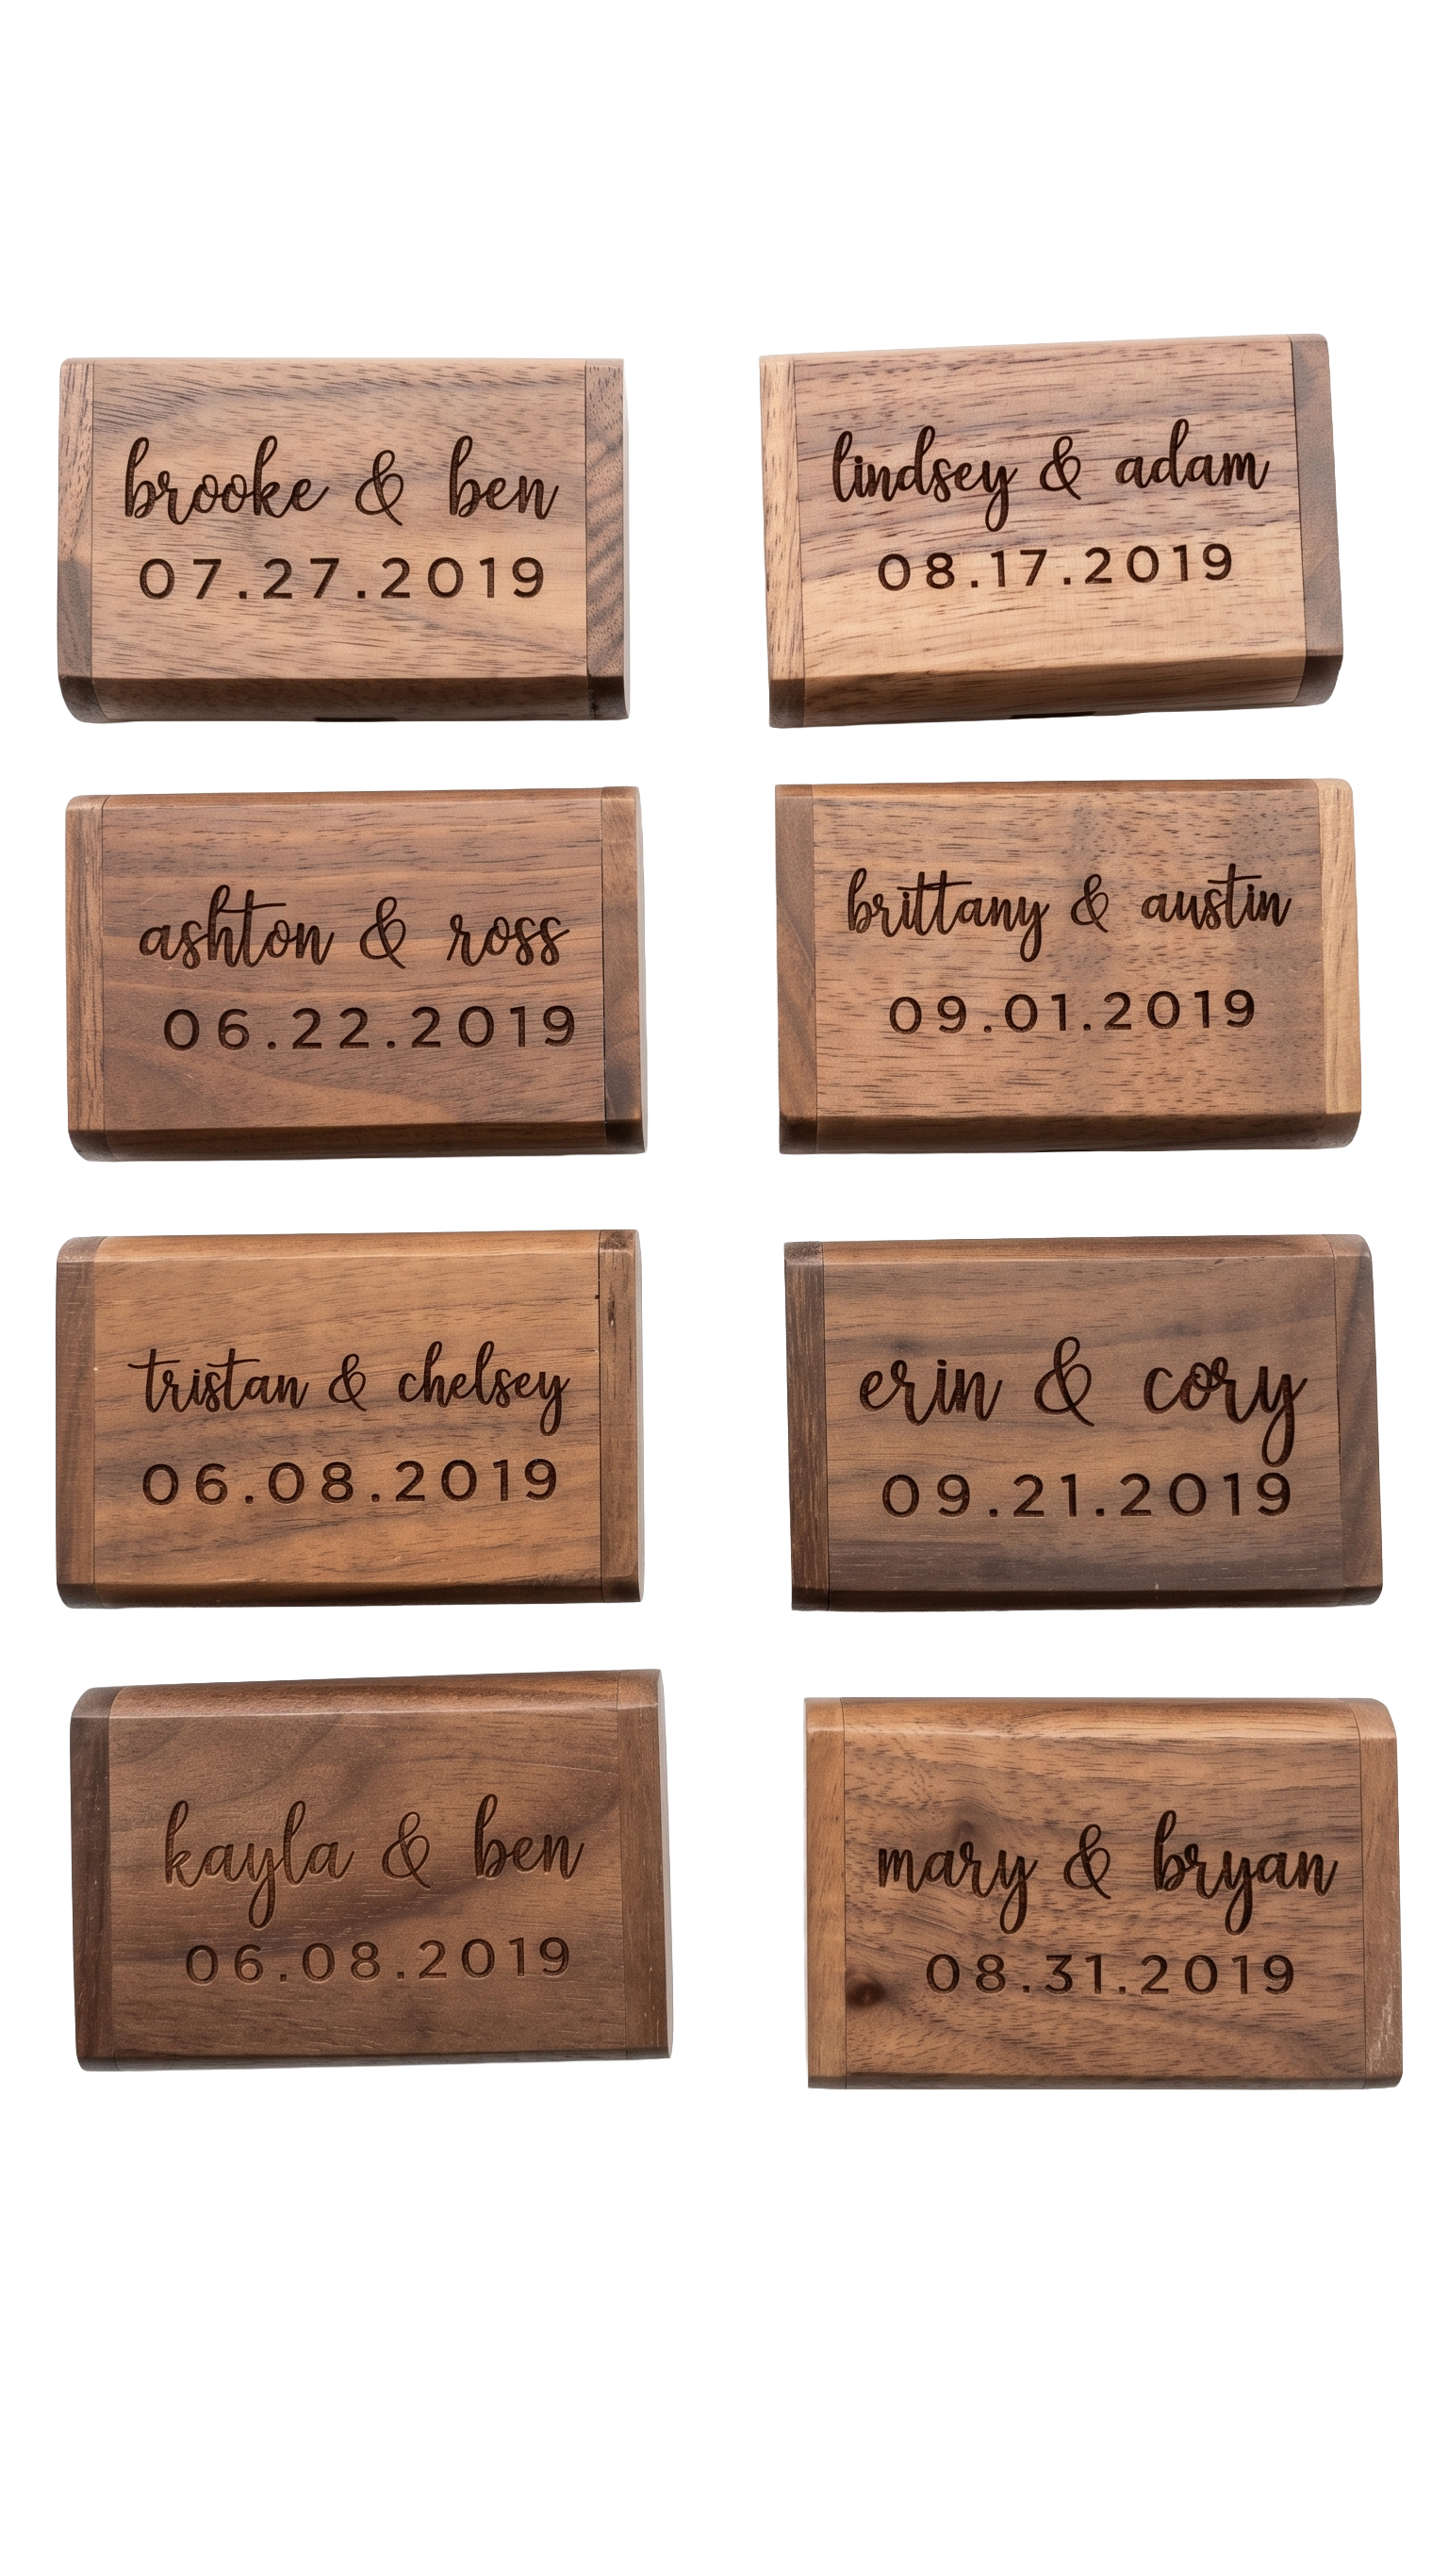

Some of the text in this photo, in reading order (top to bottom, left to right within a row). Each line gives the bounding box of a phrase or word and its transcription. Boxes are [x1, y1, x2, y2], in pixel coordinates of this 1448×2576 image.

[124, 435, 559, 526] brooke & ben
[831, 419, 1270, 532] lindsey & adam
[139, 556, 545, 600] 07.27.2019
[877, 543, 1232, 591] 08.17.2019
[139, 884, 569, 969] ashton & ross
[847, 863, 1292, 963] brittany & austin
[163, 1005, 575, 1051] 06.22.2019
[888, 989, 1255, 1034] 09.01.2019
[127, 1340, 570, 1437] tristan & chelsey
[859, 1336, 1308, 1468] erin & cory
[141, 1459, 557, 1506] 06.08.2019
[880, 1472, 1291, 1519] 09.21.2019
[164, 1794, 584, 1929] kayla & ben
[878, 1809, 1339, 1935] mary & bryan
[187, 1937, 569, 1985] 06.08.2019
[925, 1954, 1294, 1995] 08.31.2019
